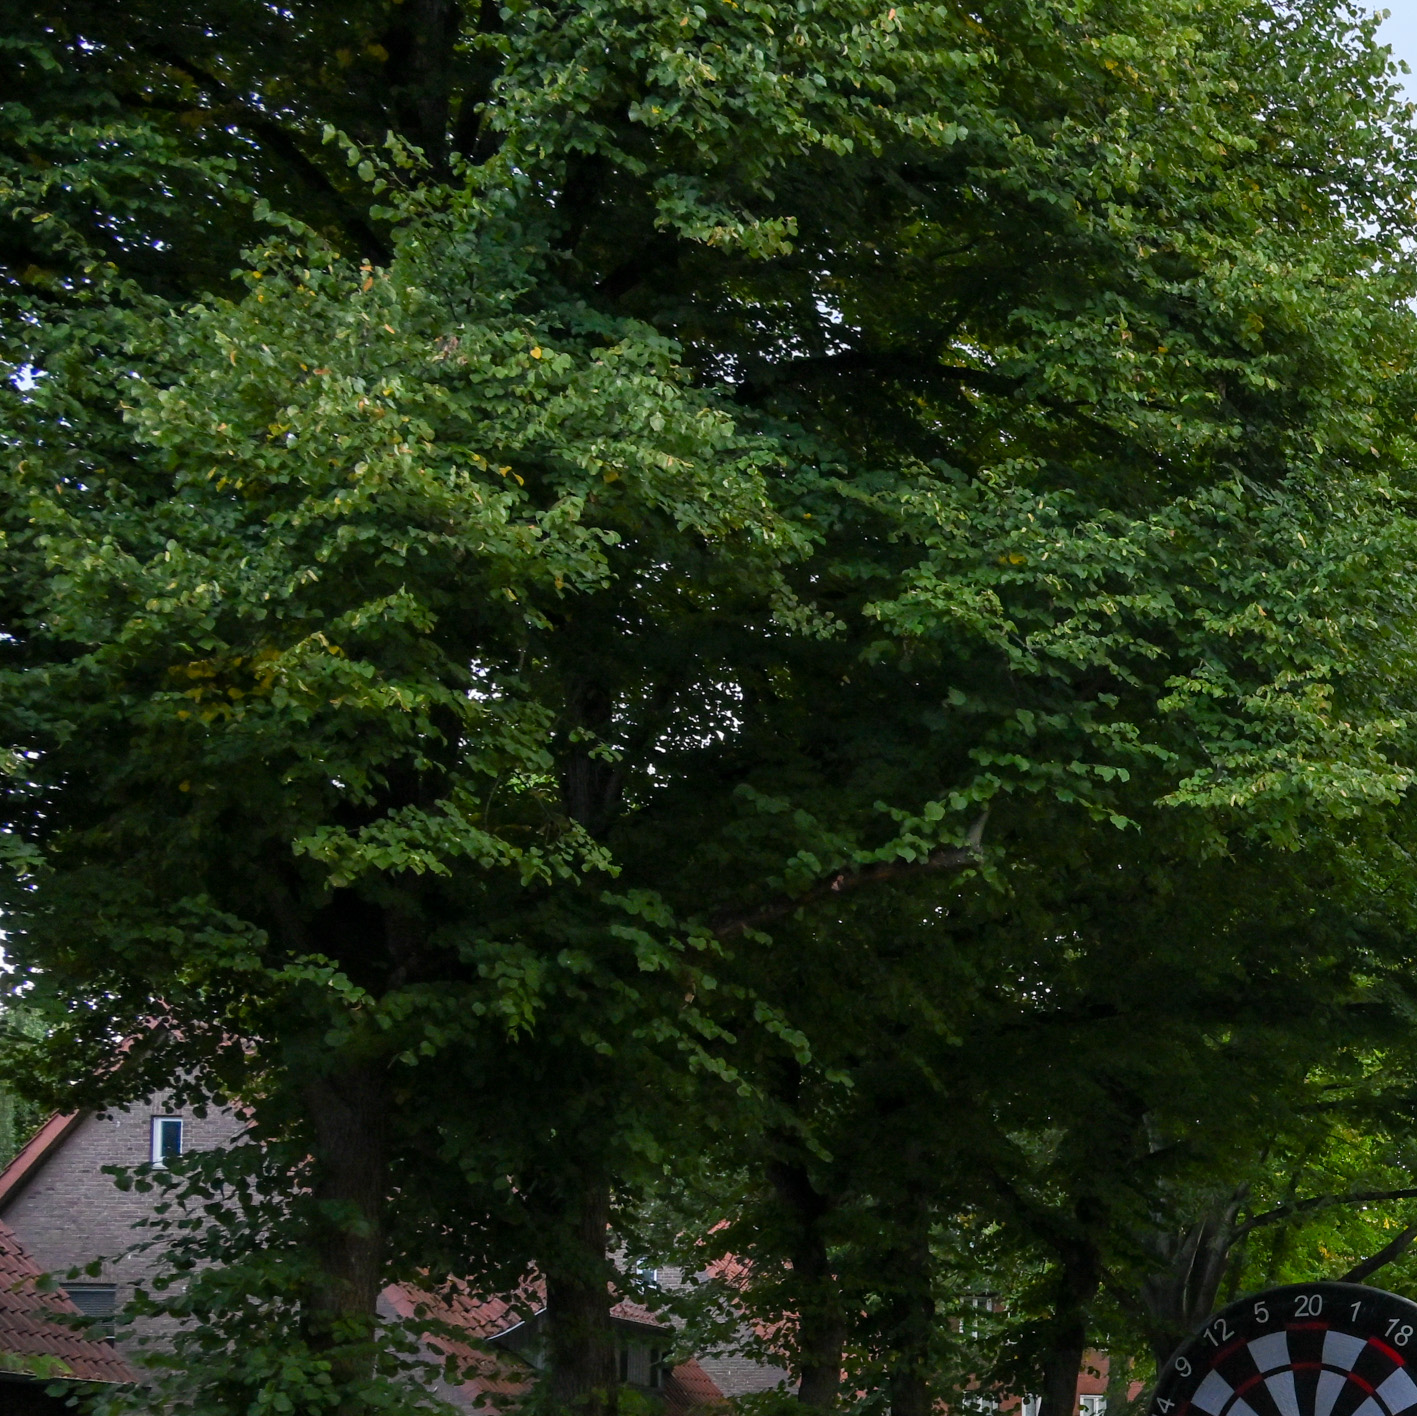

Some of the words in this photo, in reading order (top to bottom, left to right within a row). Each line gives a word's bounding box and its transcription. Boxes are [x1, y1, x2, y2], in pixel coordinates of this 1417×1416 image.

[1254, 1301, 1270, 1323] 5
[1294, 1294, 1323, 1317] 20
[1350, 1301, 1362, 1322] 1
[1203, 1318, 1235, 1347] 12
[1384, 1318, 1414, 1347] 18
[1175, 1356, 1192, 1377] 9
